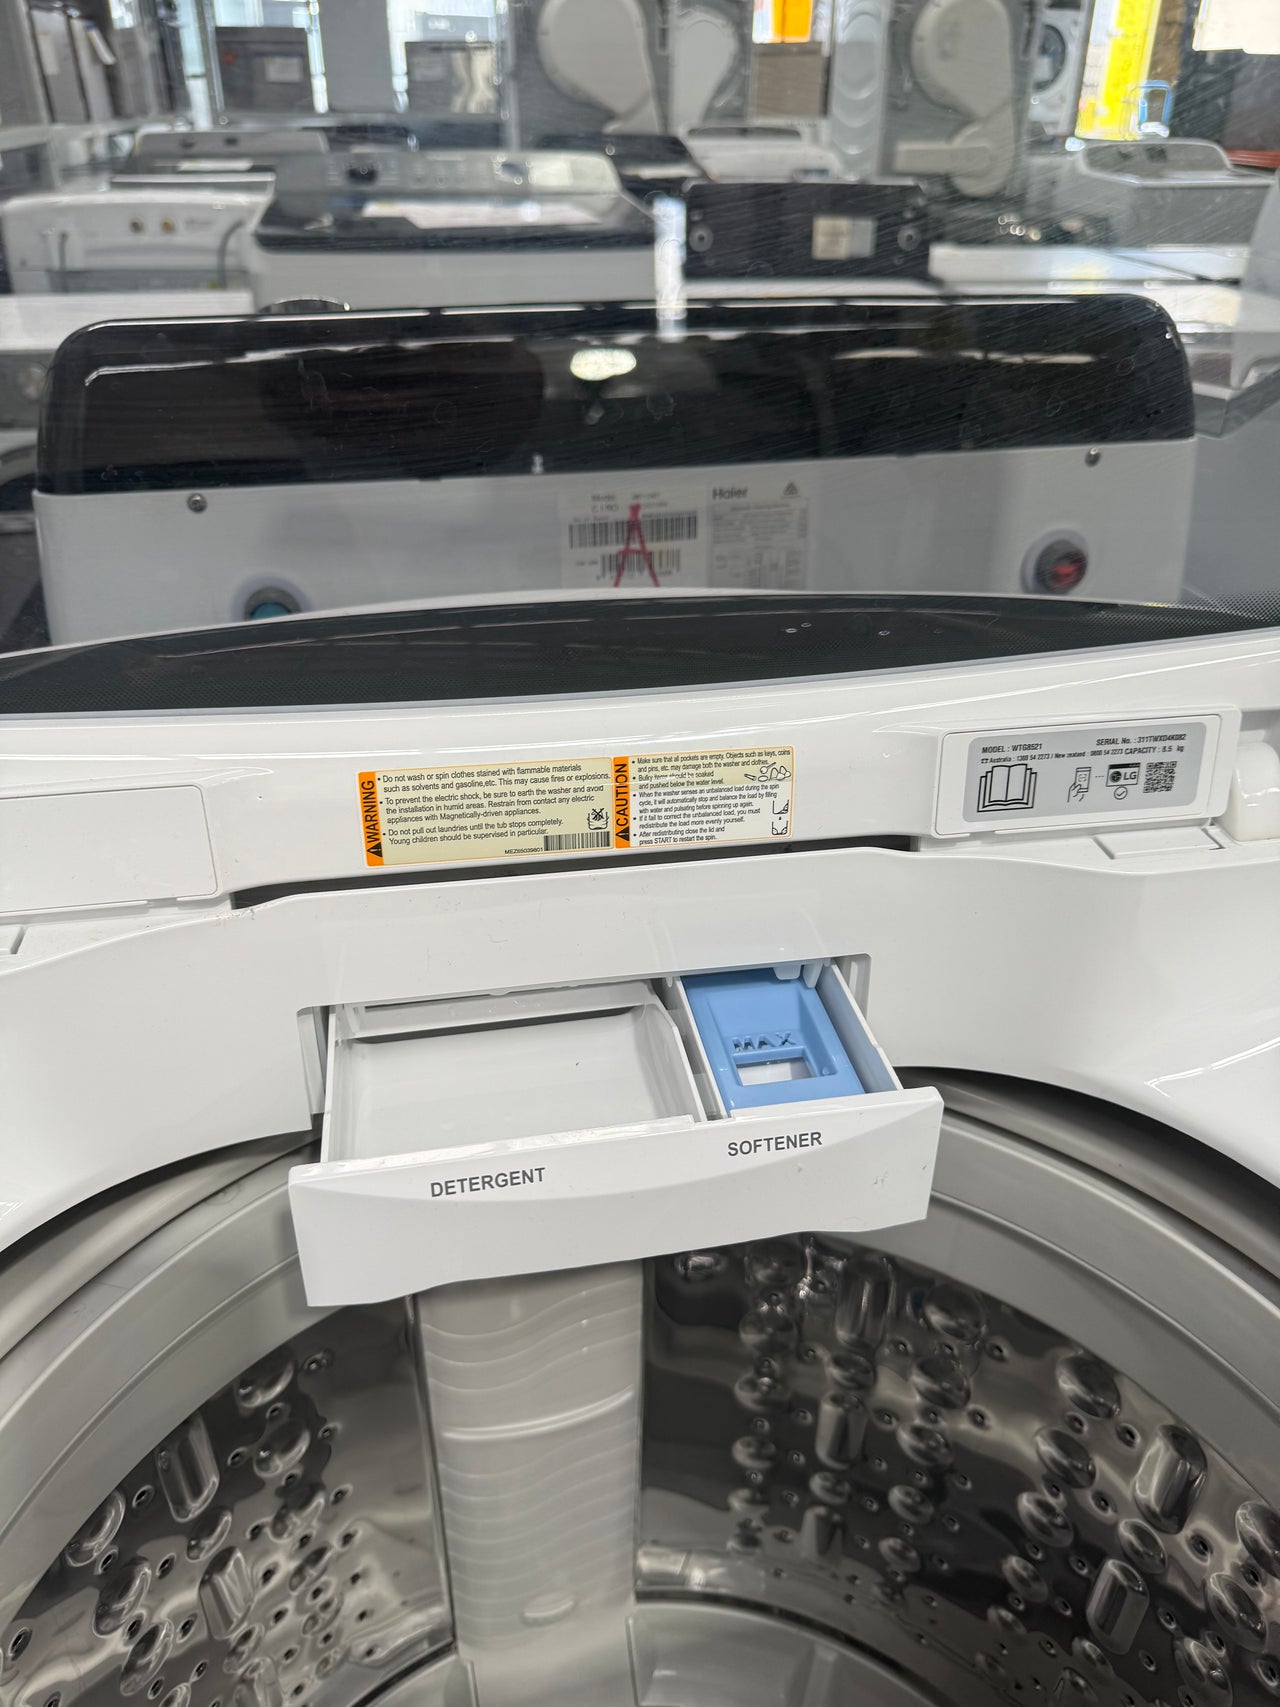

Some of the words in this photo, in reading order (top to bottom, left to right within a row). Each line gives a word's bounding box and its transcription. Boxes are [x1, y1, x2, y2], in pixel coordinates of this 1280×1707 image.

[712, 486, 748, 500] Haier
[981, 745, 1004, 753] MODEL
[1011, 742, 1042, 751] WTG8521
[1095, 737, 1119, 746] SERIAL
[1124, 746, 1156, 754] CAPACITY
[435, 771, 449, 780] spin
[516, 765, 550, 774] flammable
[551, 764, 580, 772] materials
[1123, 771, 1137, 780] LG
[411, 782, 439, 790] solvents
[394, 796, 421, 806] prevent
[614, 764, 628, 826] CAUTION
[361, 780, 380, 843] WARNING
[398, 805, 434, 813] installation
[386, 814, 423, 825] appliances
[439, 809, 503, 822] Magnetically-driven
[411, 827, 424, 835] pull
[508, 820, 526, 829] stops
[389, 837, 410, 846] Young
[411, 835, 438, 843] children
[472, 830, 508, 841] supervised
[731, 1032, 796, 1051] MAX
[727, 1131, 822, 1157] SOFTENER
[430, 1167, 546, 1198] DETERGENT
